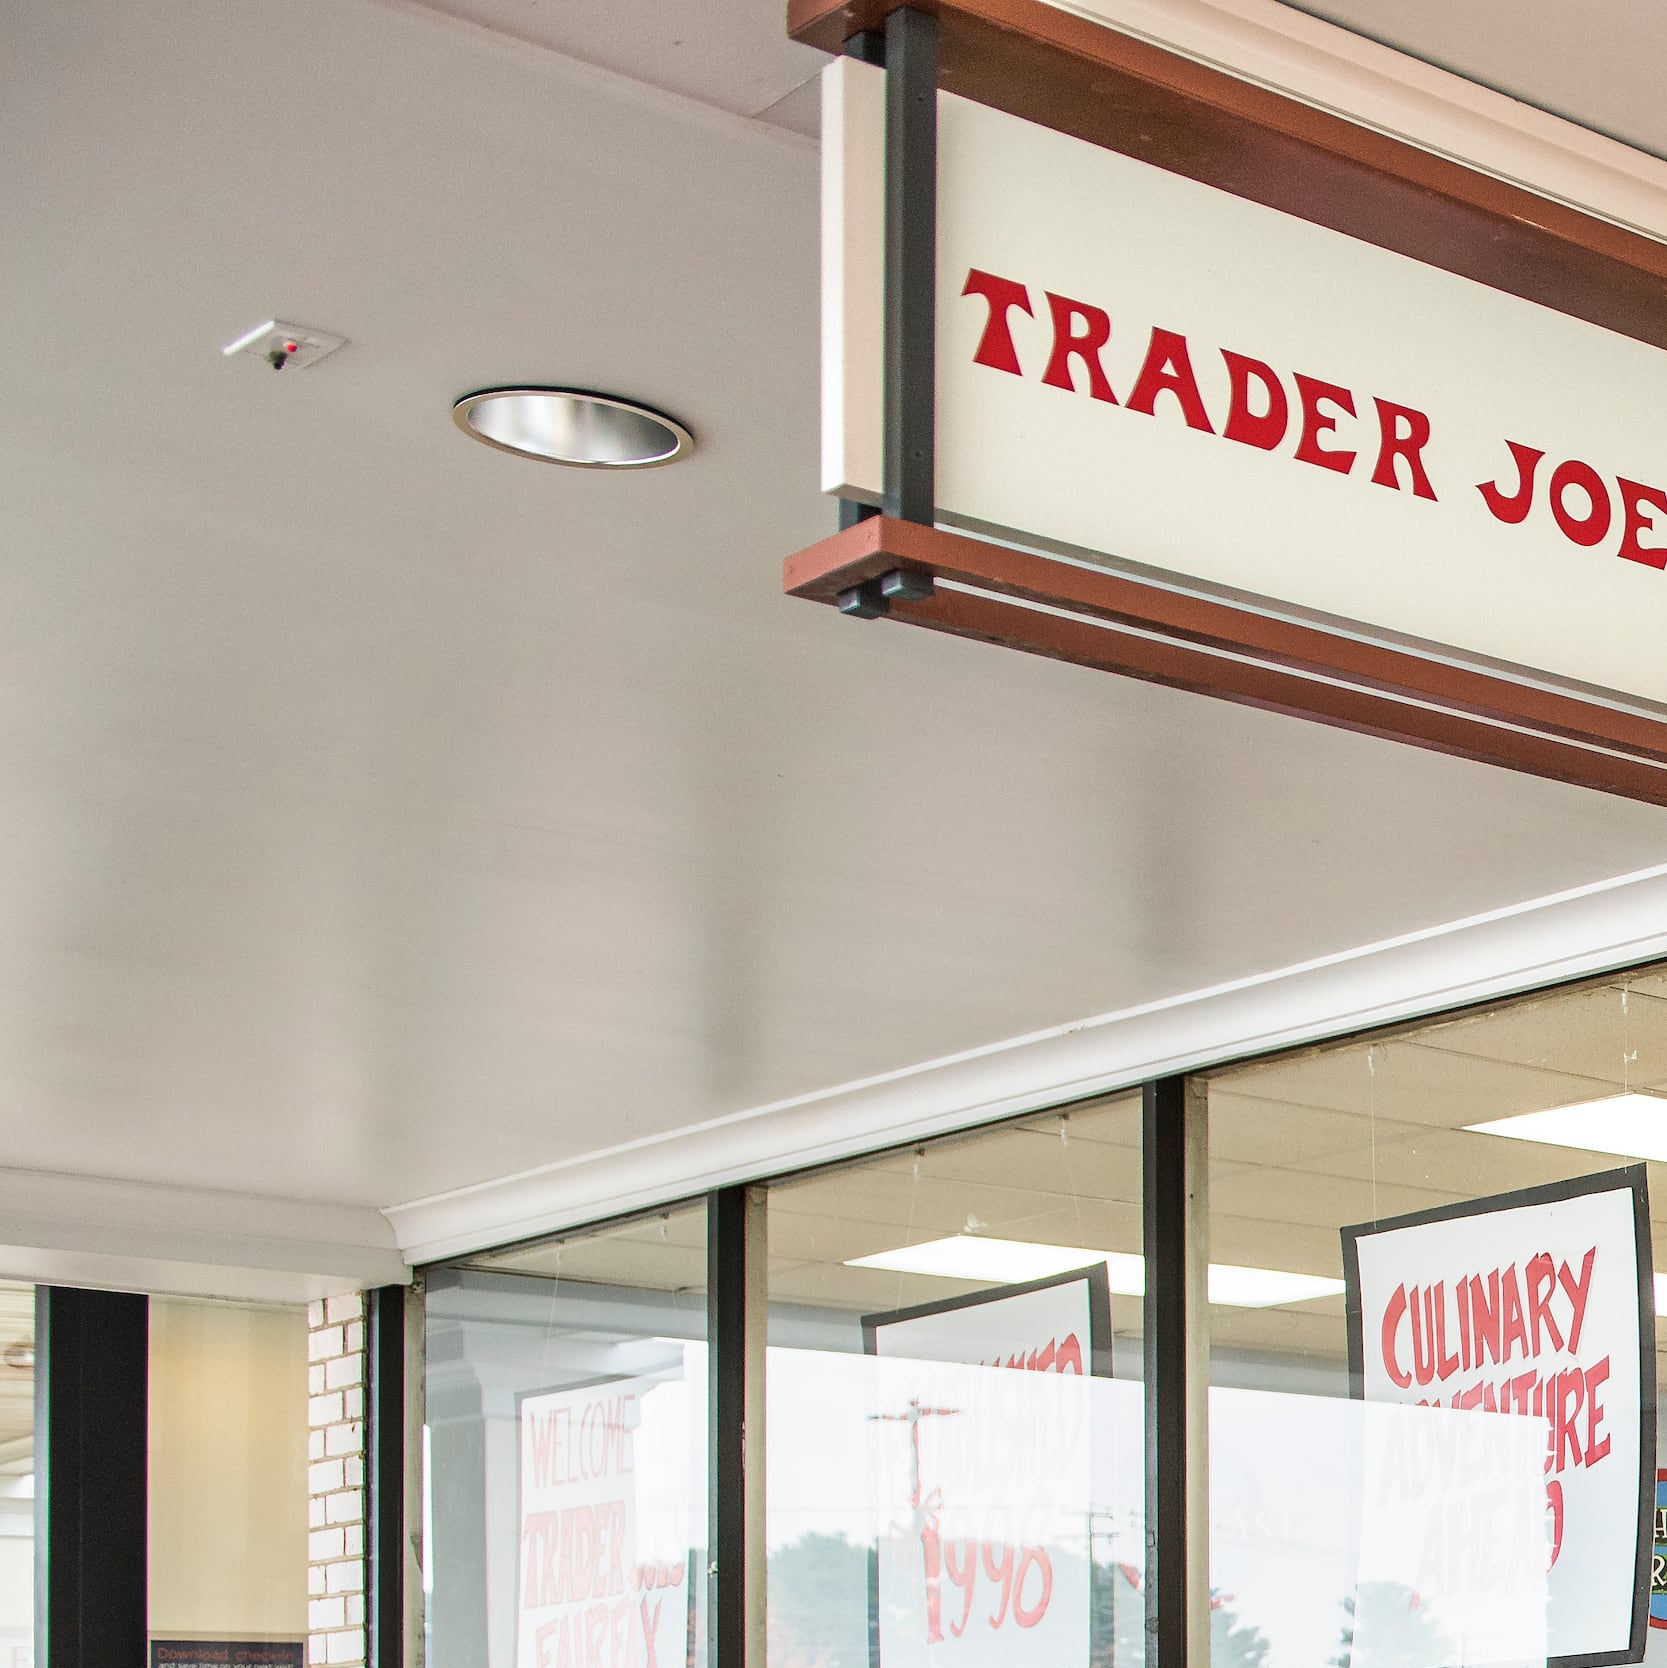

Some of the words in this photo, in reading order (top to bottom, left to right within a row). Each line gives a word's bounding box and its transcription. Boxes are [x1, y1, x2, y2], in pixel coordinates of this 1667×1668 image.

[961, 267, 1439, 502] TRADER
[1381, 1246, 1597, 1390] CULINARY
[530, 1394, 636, 1489] WELCOME
[522, 1499, 628, 1610] TRADER
